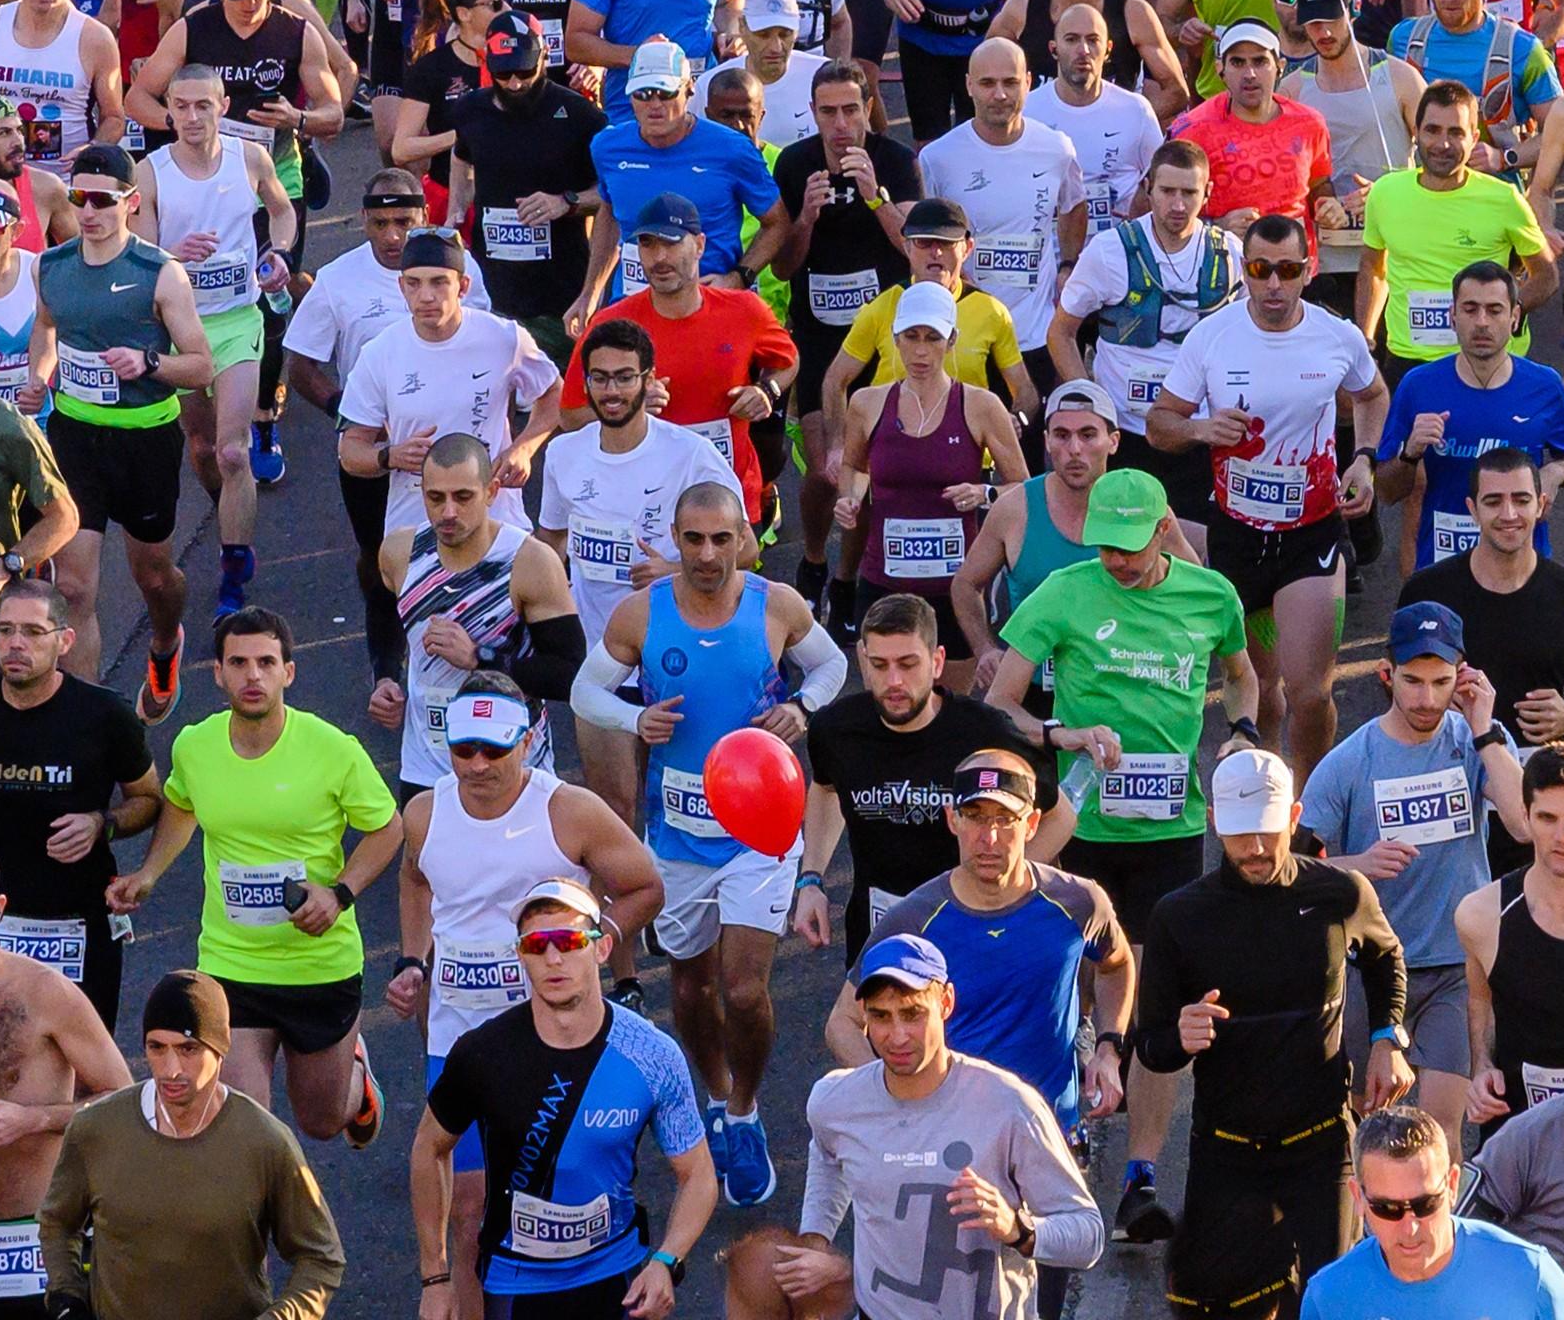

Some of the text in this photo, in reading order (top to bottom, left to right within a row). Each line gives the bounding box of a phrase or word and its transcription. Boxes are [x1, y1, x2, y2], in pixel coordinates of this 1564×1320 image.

[499, 228, 531, 245] 2435
[993, 252, 1027, 269] 2623
[200, 268, 231, 287] 2535
[827, 291, 861, 309] 2028
[72, 368, 97, 386] 1068
[1250, 481, 1279, 500] 798
[581, 539, 612, 561] 1191
[903, 540, 941, 558] 3321
[1110, 647, 1166, 662] Schneider
[1133, 666, 1170, 680] PARIS
[45, 765, 72, 784] Tri
[1126, 775, 1166, 795] 1023
[1404, 782, 1443, 793] SAMSUNG
[1408, 798, 1441, 822] 937
[243, 872, 279, 880] SAMSUNG
[242, 885, 283, 905] 2585
[18, 940, 60, 959] 2732
[459, 950, 495, 958] SAMSUNG
[456, 964, 497, 986] 2430
[542, 1207, 585, 1219] SAMSUNG
[538, 1220, 587, 1241] 3105
